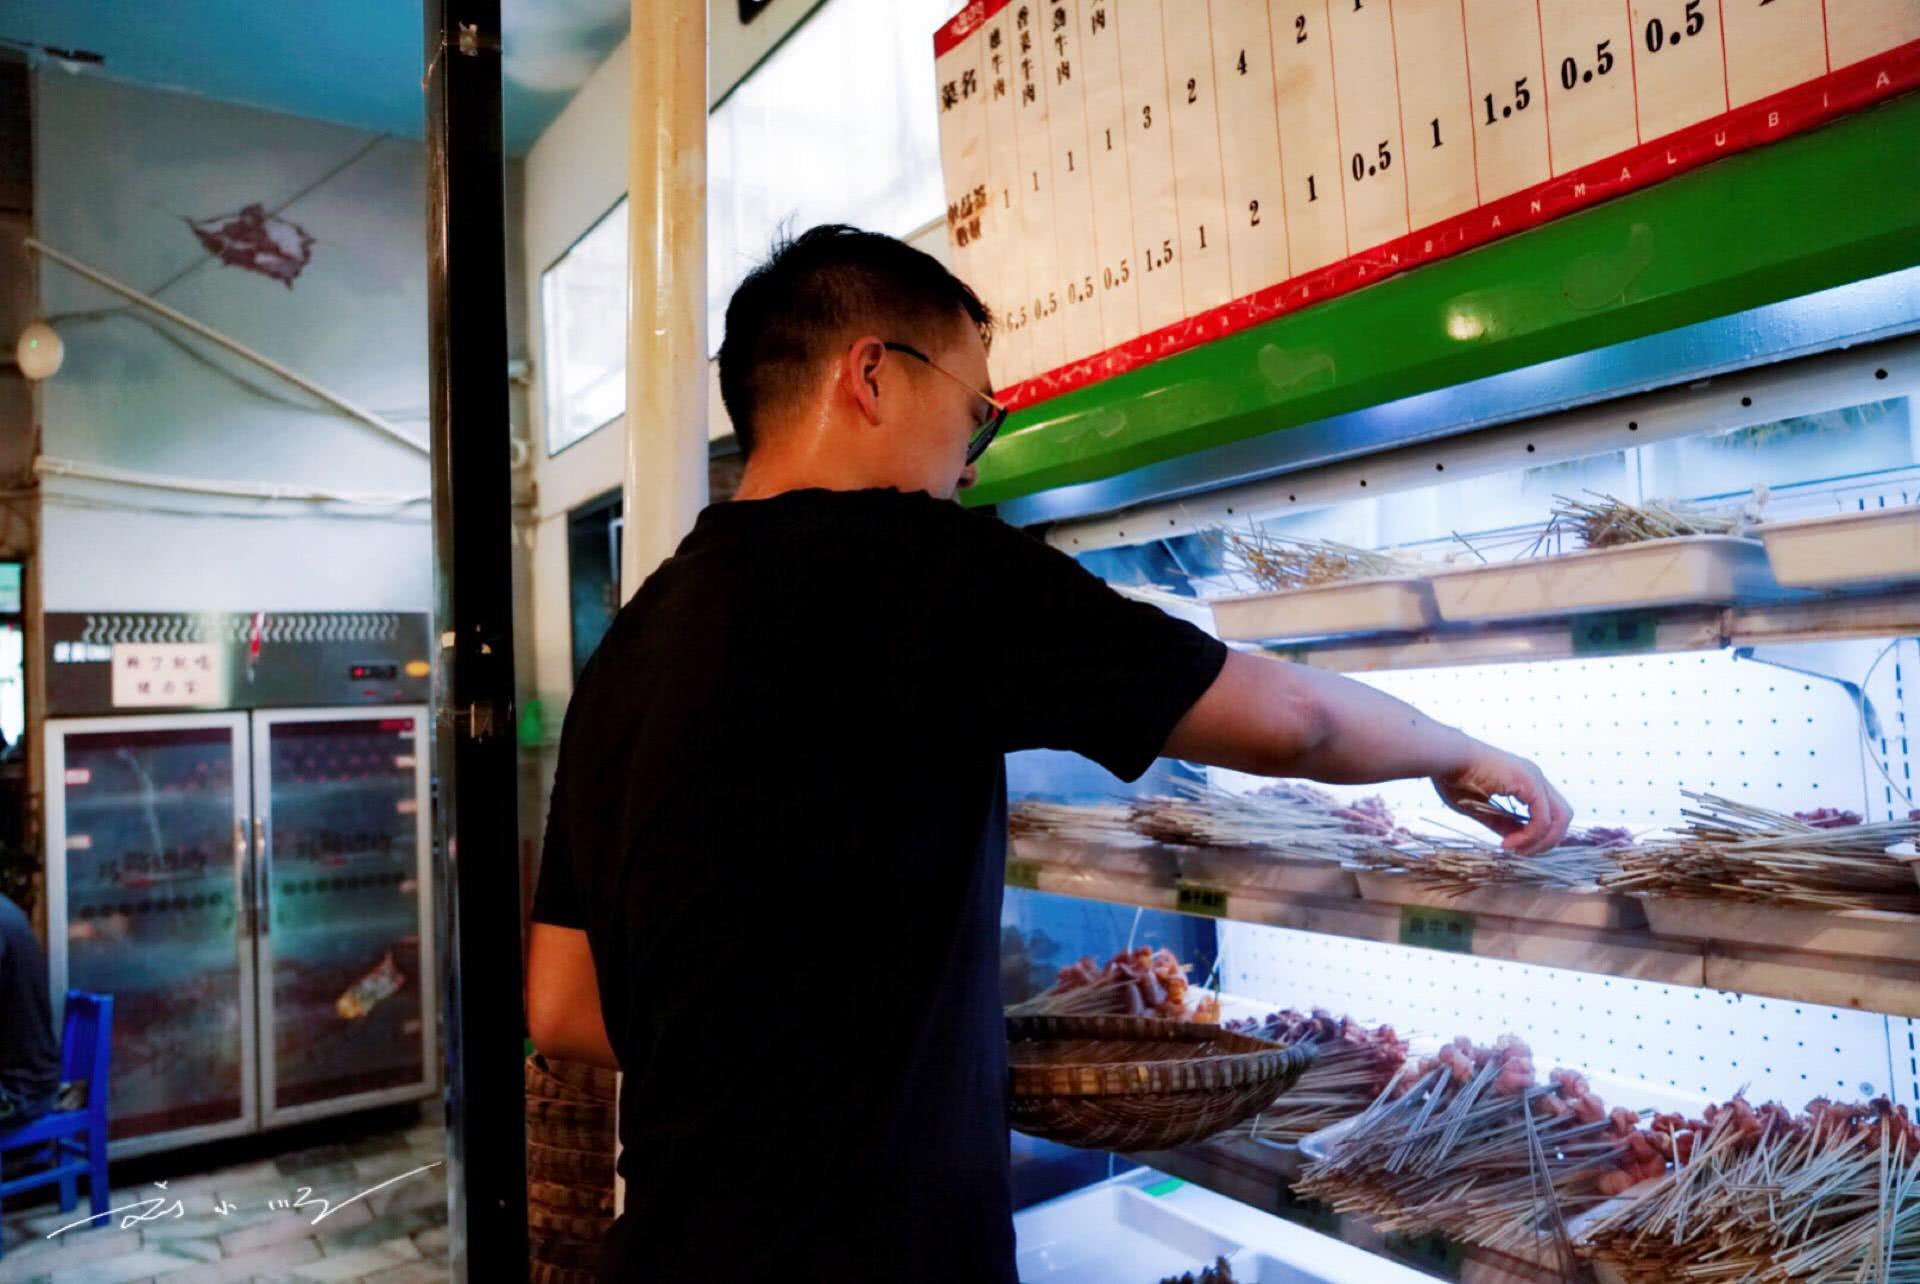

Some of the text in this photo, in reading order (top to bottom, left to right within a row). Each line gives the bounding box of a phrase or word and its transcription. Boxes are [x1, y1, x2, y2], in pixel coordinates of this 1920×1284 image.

[1032, 170, 1040, 192] 1
[1067, 151, 1075, 172] 1
[1105, 128, 1113, 151] 1
[1142, 105, 1152, 129] 3
[1186, 77, 1197, 105] 2
[1236, 49, 1248, 76] 4
[1295, 14, 1308, 45] 2
[1034, 292, 1058, 320] 0.5
[1068, 276, 1094, 303] 0.5
[1103, 259, 1130, 290] 0.5
[1145, 239, 1174, 272] 1.5
[1199, 225, 1207, 249] 1
[1248, 199, 1261, 227] 2
[1307, 175, 1318, 203] 1
[1351, 139, 1392, 182] 0.5
[1430, 117, 1444, 149] 1
[1483, 76, 1531, 126] 1.5
[1560, 39, 1614, 91] 0.5
[1645, 0, 1705, 54] 0.5
